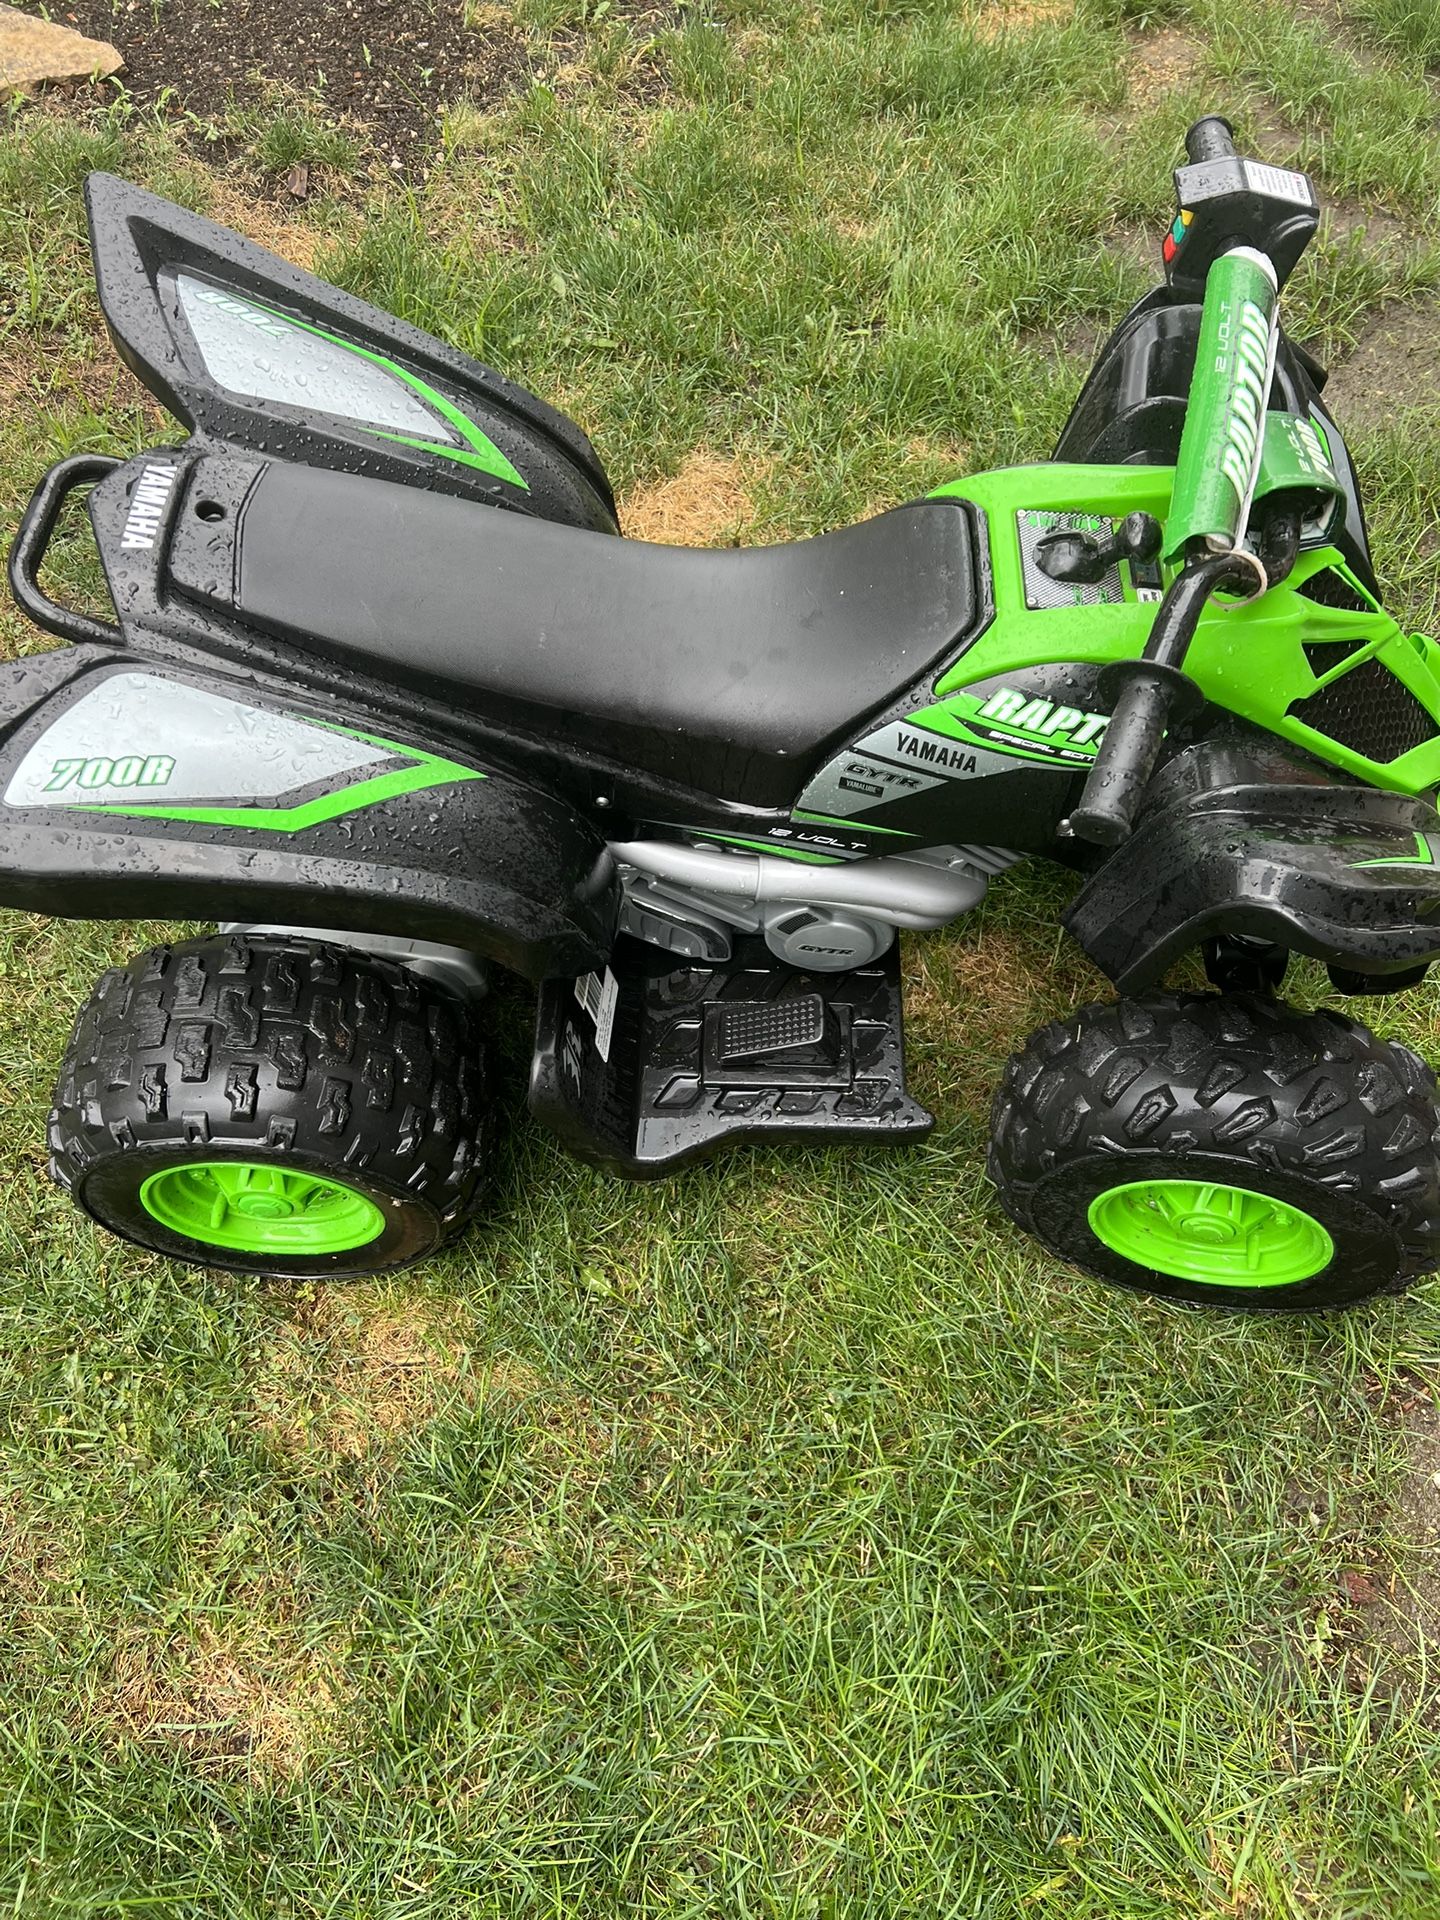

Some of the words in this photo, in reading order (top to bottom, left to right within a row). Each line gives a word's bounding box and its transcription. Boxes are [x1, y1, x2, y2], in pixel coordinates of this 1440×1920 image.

[1218, 301, 1232, 352] VOLT
[1214, 355, 1228, 373] 12
[121, 464, 178, 548] YAMAHA
[974, 686, 1111, 749] RAPT
[896, 731, 977, 774] YAMAHA
[988, 730, 1056, 754] SPECIAL
[1060, 749, 1096, 762] EDIT
[40, 754, 177, 792] 700R
[844, 761, 923, 790] GYTR
[768, 827, 793, 838] 12
[796, 832, 867, 850] VOLT
[797, 944, 857, 957] GYTR
